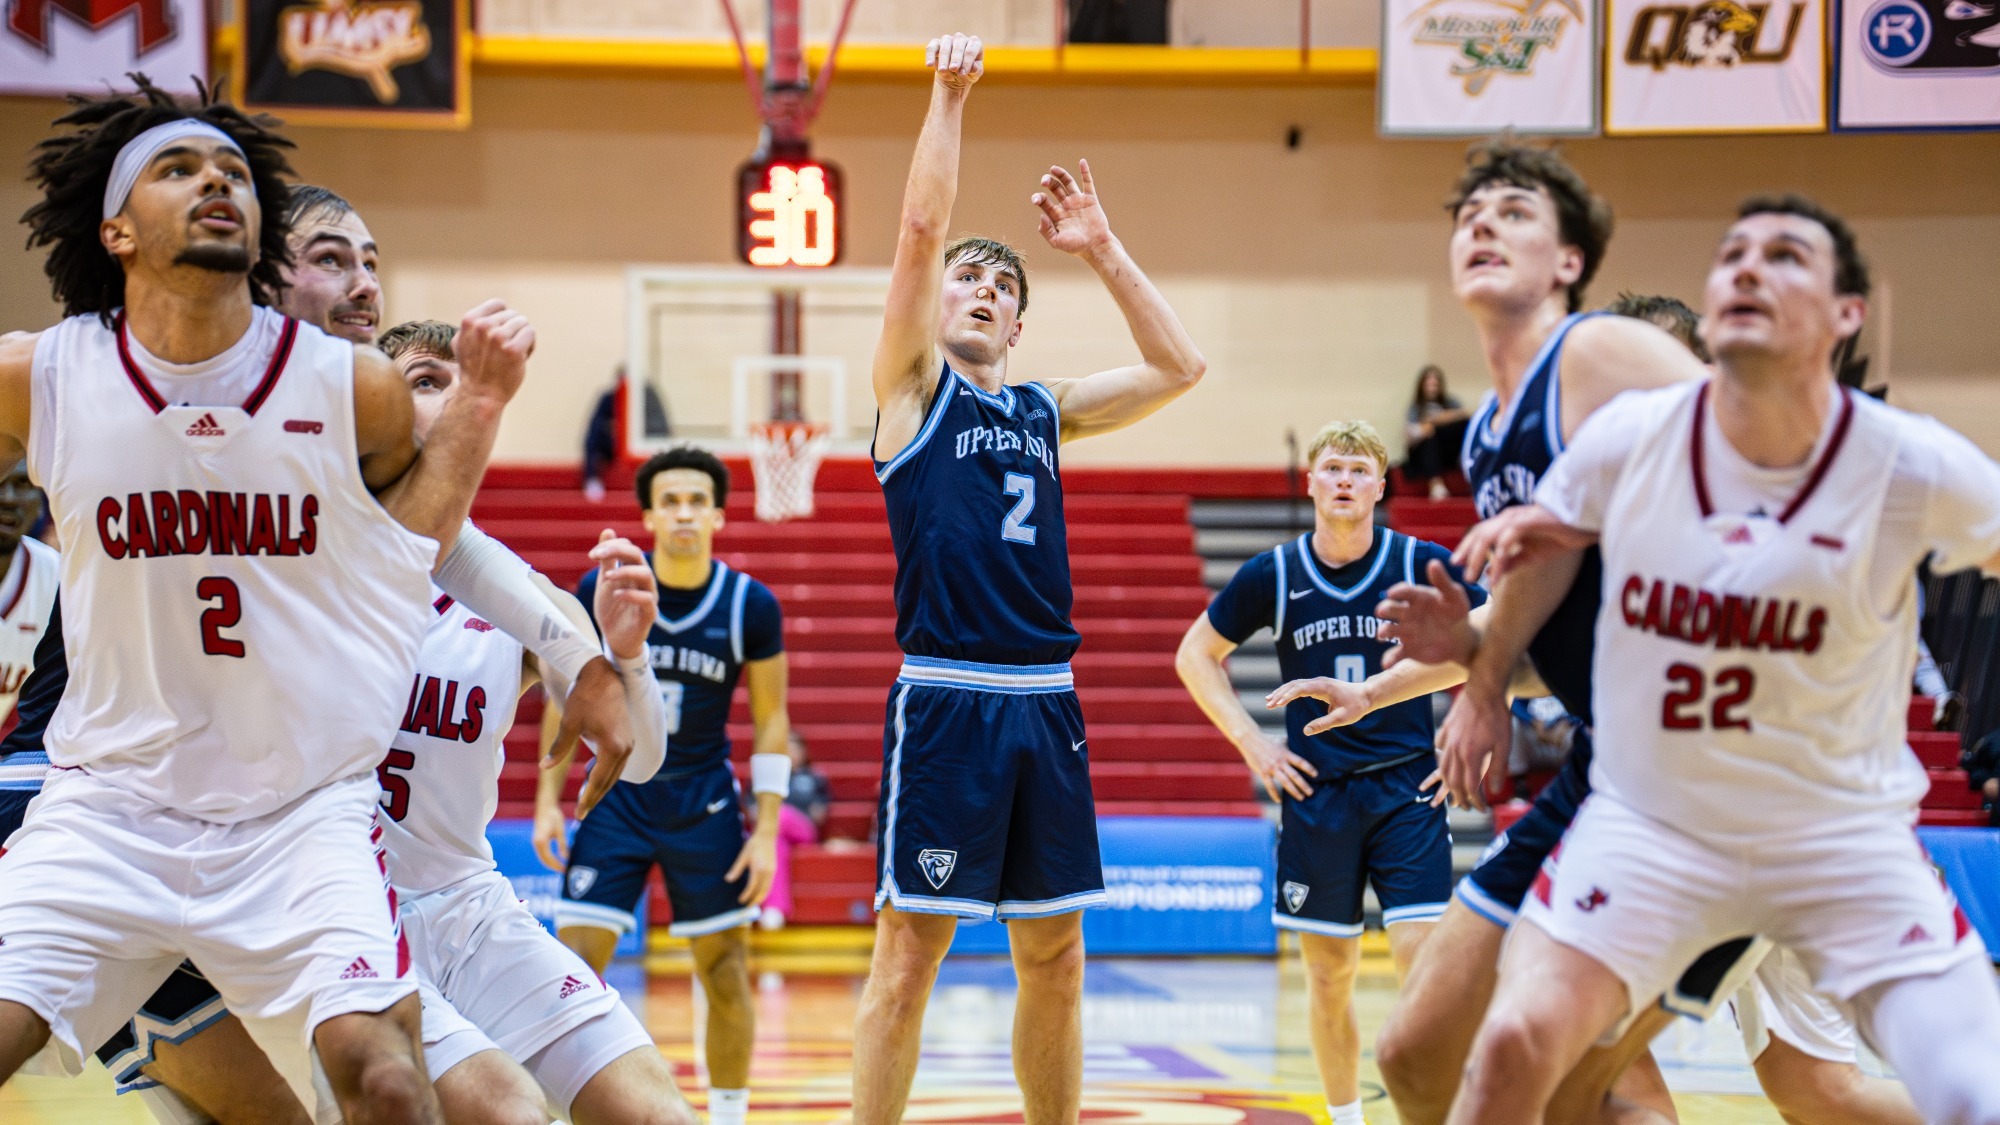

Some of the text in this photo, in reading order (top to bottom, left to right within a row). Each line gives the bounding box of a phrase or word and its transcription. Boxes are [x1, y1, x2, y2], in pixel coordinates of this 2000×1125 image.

[748, 192, 835, 267] 30
[185, 427, 226, 437] adidas
[956, 425, 1022, 460] UPPER
[97, 489, 319, 560] CARDINALS
[1001, 471, 1037, 546] 2
[196, 576, 246, 658] 2
[1292, 615, 1400, 651] UPPER IO
[1621, 573, 1828, 655] CARDINALS
[1661, 661, 1756, 733] 22
[339, 968, 379, 980] adidas
[559, 983, 591, 1000] adidas
